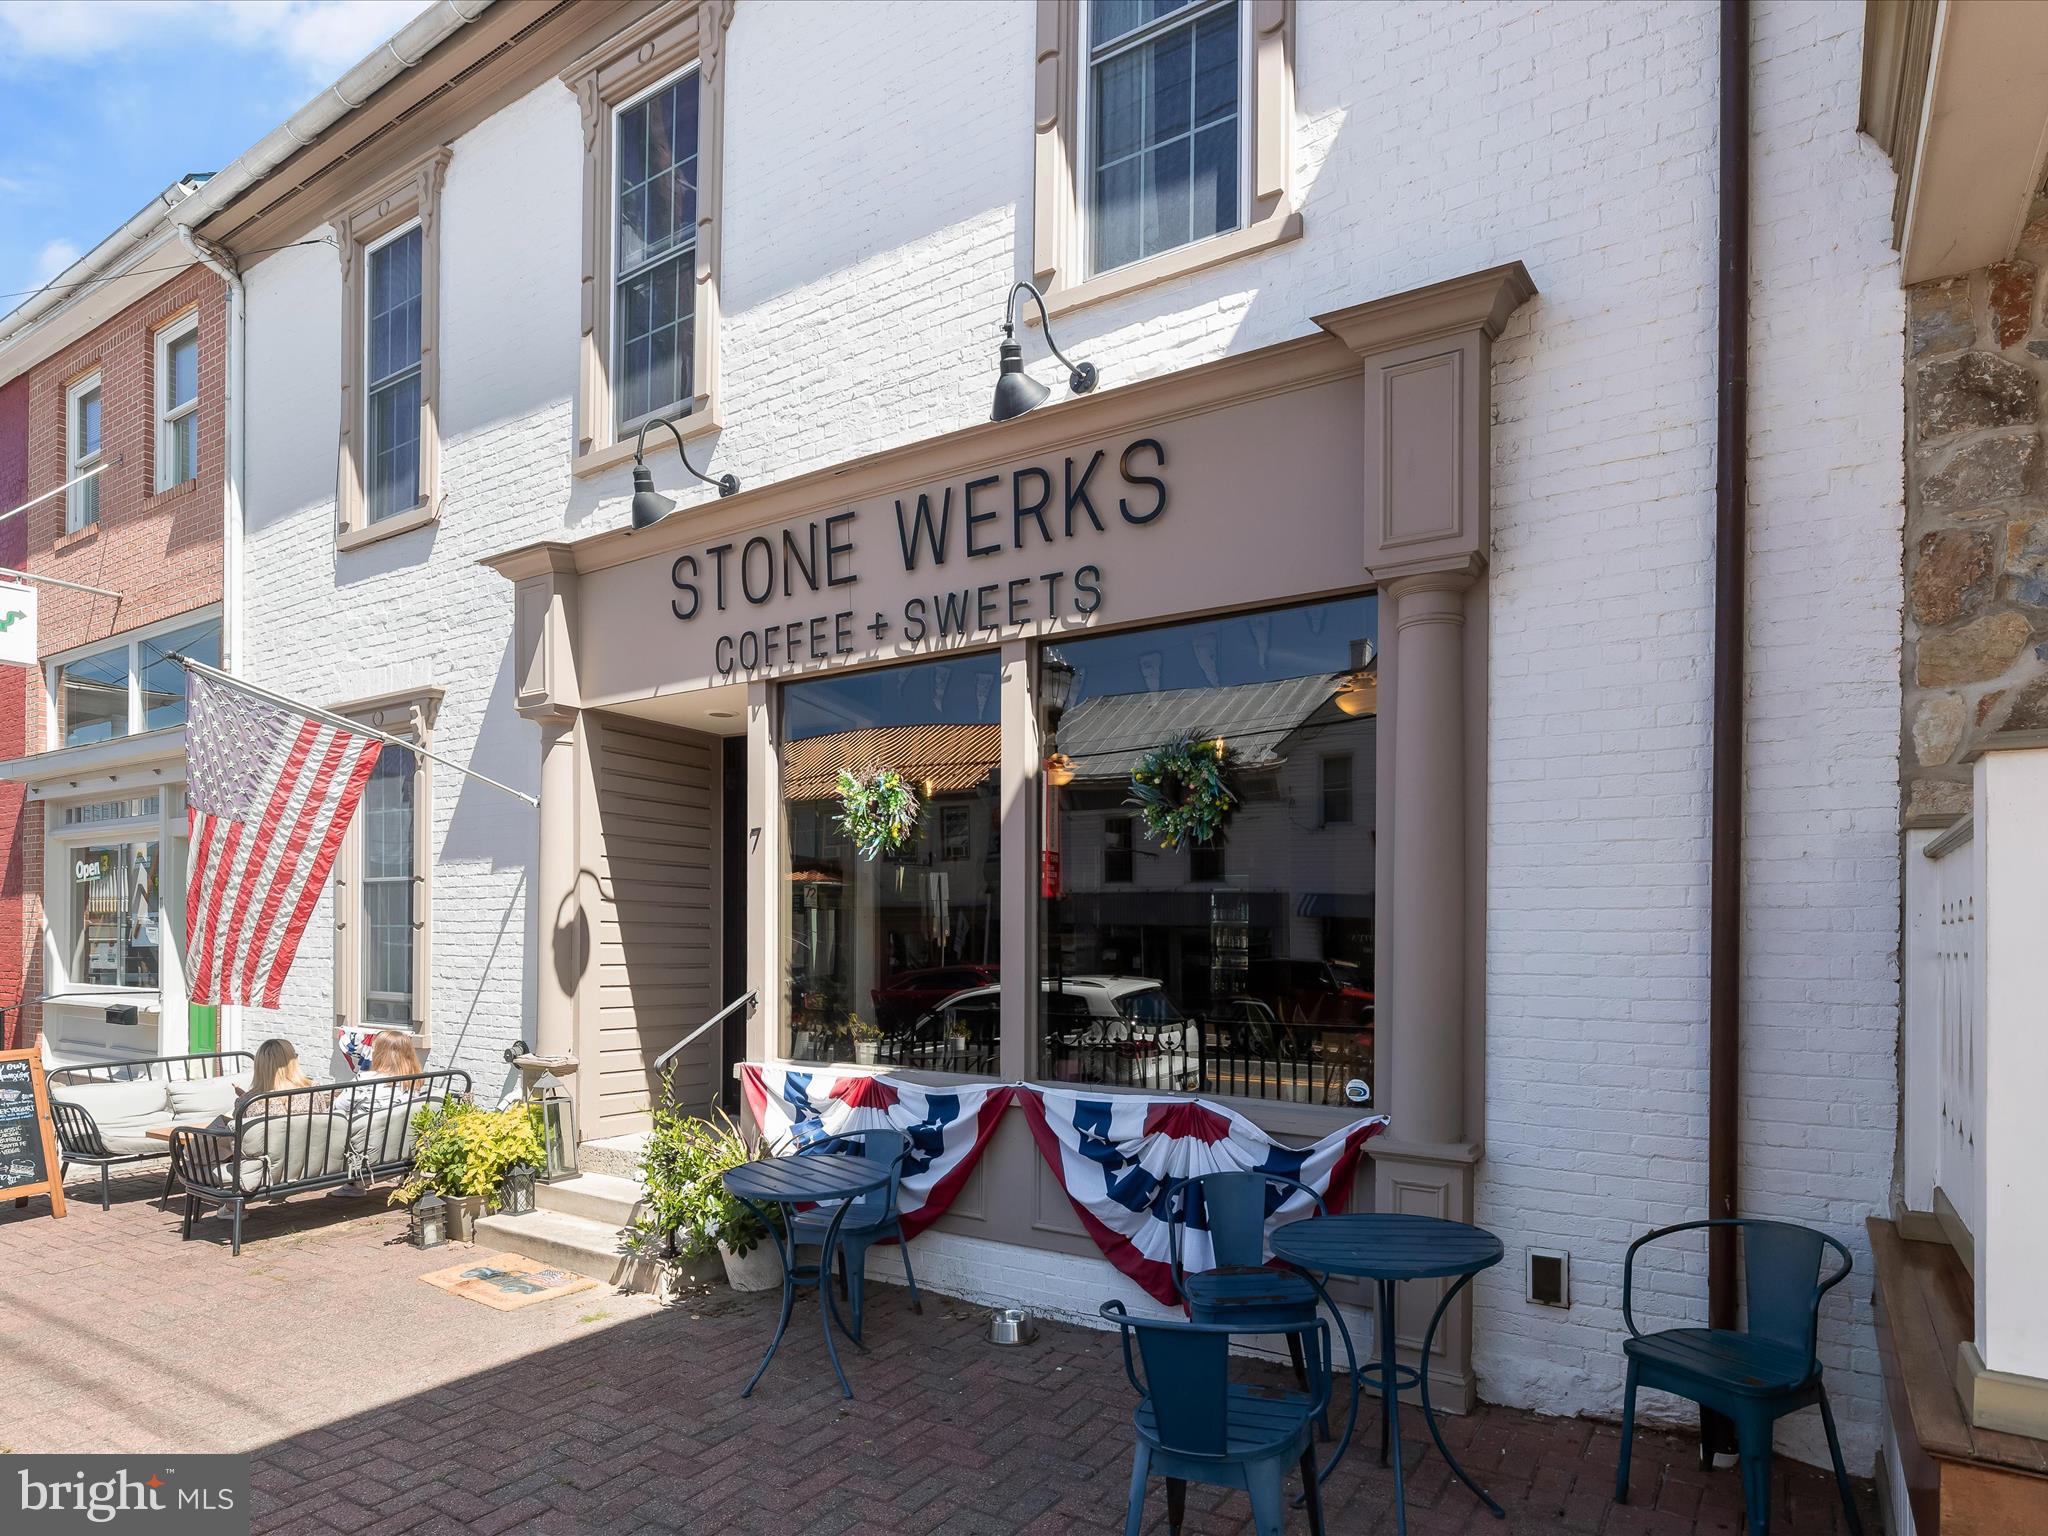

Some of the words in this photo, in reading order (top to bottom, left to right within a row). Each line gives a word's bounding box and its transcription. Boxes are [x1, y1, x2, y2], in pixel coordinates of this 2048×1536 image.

[670, 511, 858, 620] STONE
[895, 438, 1167, 572] WERKS
[715, 611, 854, 676] COFFEE
[903, 564, 1102, 642] SWEETS
[75, 860, 100, 881] Open
[749, 827, 762, 855] 7
